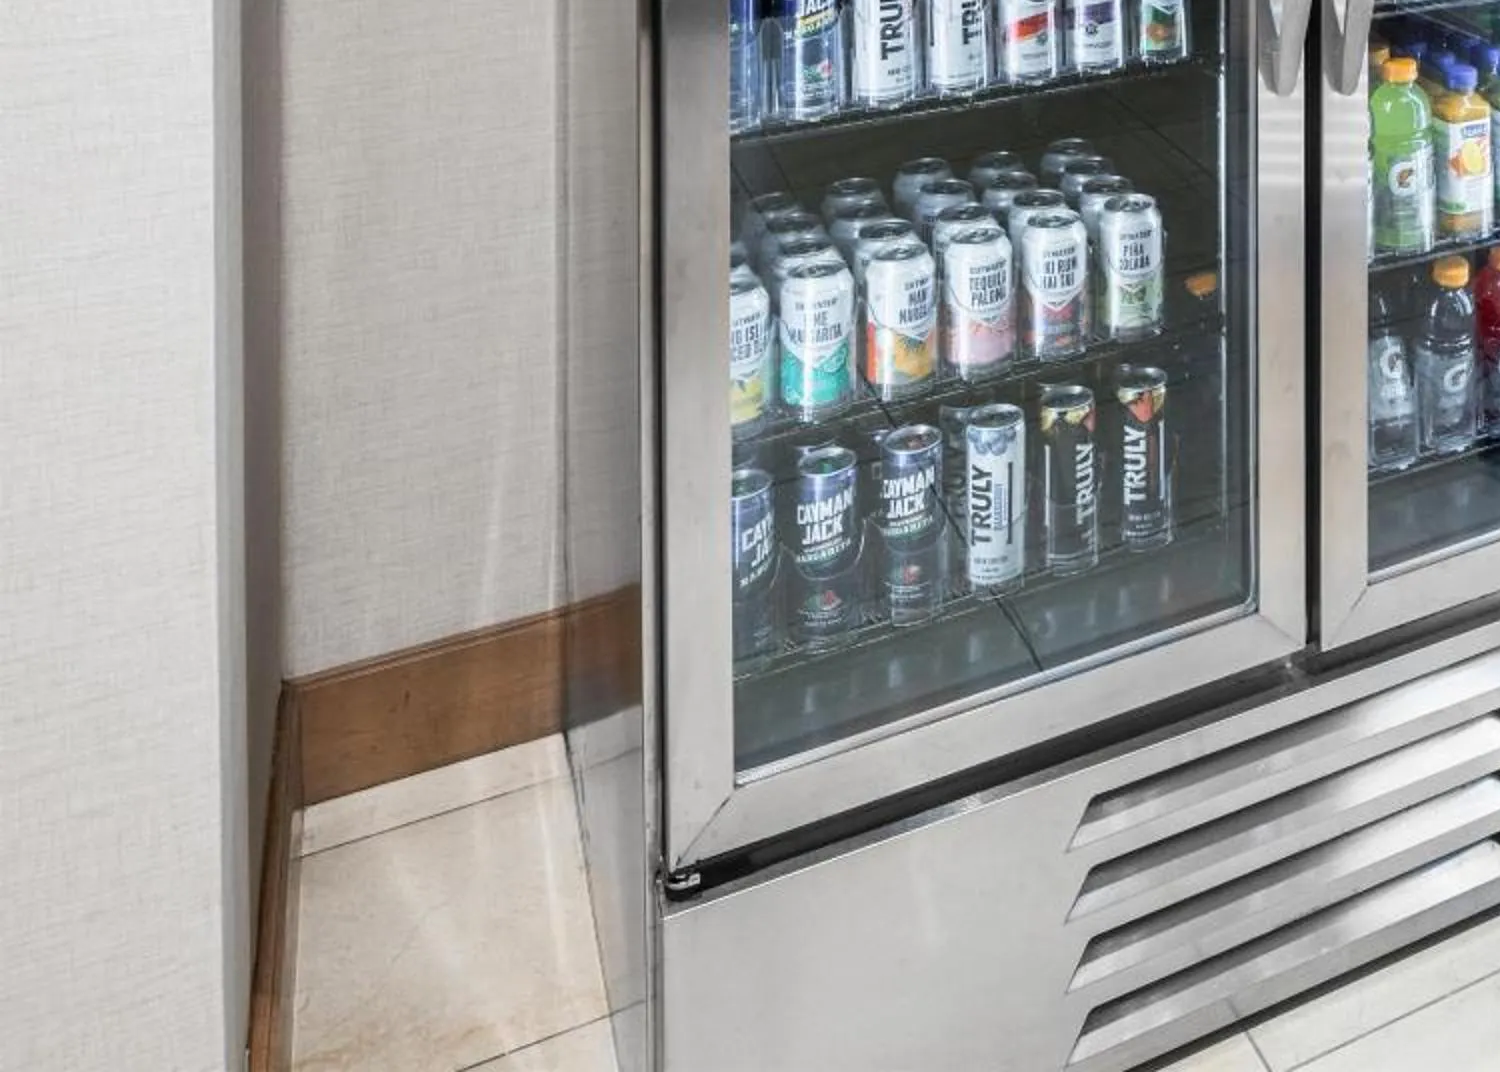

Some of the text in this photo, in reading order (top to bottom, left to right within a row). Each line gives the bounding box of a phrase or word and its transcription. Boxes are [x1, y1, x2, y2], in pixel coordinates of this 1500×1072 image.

[883, 465, 935, 500] CAYMAN
[1076, 442, 1094, 525] TRULY
[1124, 425, 1148, 505] TRULY
[797, 488, 853, 526] CAYMAN
[886, 493, 925, 520] JACK
[971, 464, 993, 547] TRULY
[742, 512, 773, 553] CAY
[802, 514, 844, 546] JACK
